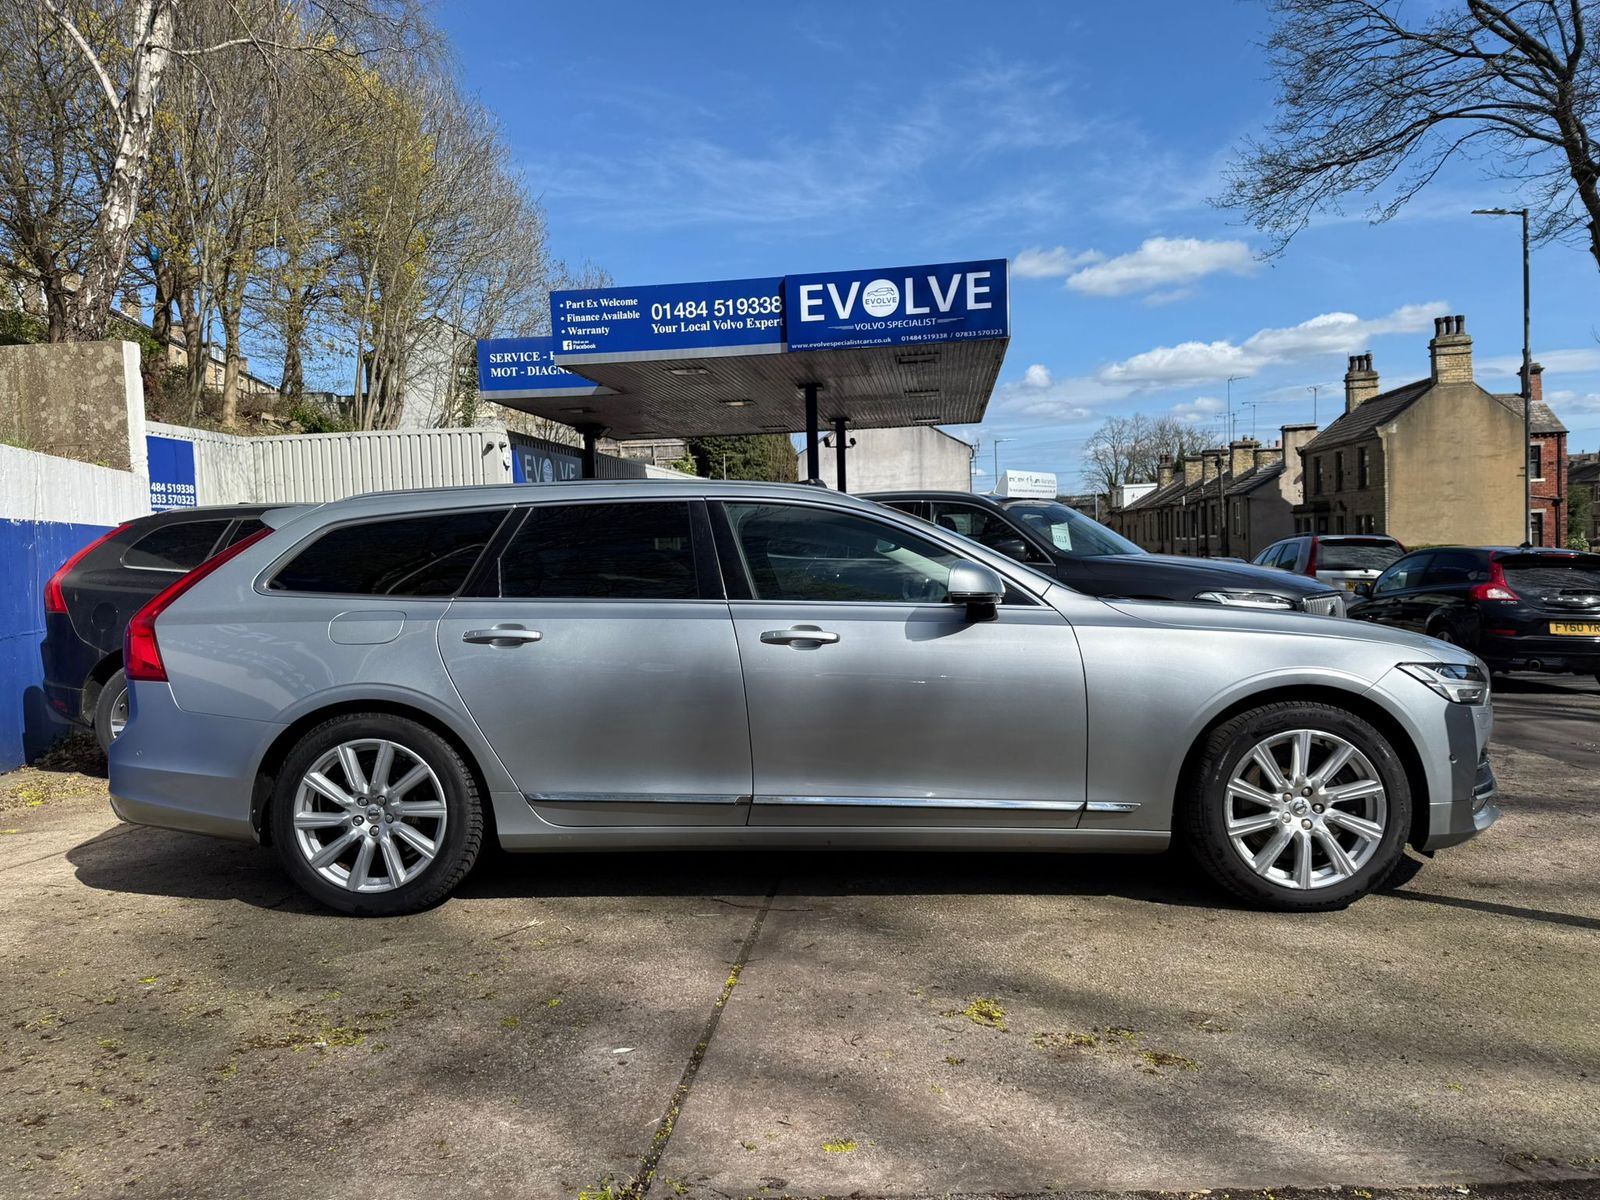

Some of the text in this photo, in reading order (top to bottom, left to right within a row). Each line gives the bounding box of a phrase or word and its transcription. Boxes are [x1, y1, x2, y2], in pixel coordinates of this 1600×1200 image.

[566, 298, 638, 309] Part Ex Welcome
[865, 297, 897, 305] EVOLVE
[651, 296, 782, 320] 01484 519338
[567, 310, 640, 322] Finance Available
[568, 326, 610, 335] Warranty
[651, 317, 783, 334] Your Local Volvo Expert
[854, 318, 936, 331] VOLVO SPECIALIST
[791, 337, 891, 349] www.evolvespecialistcars.co.uk
[489, 351, 540, 363] SERVICE
[490, 367, 518, 377] MOT
[527, 365, 572, 376] DIAGN
[167, 483, 195, 494] 519338
[167, 494, 195, 505] 570323
